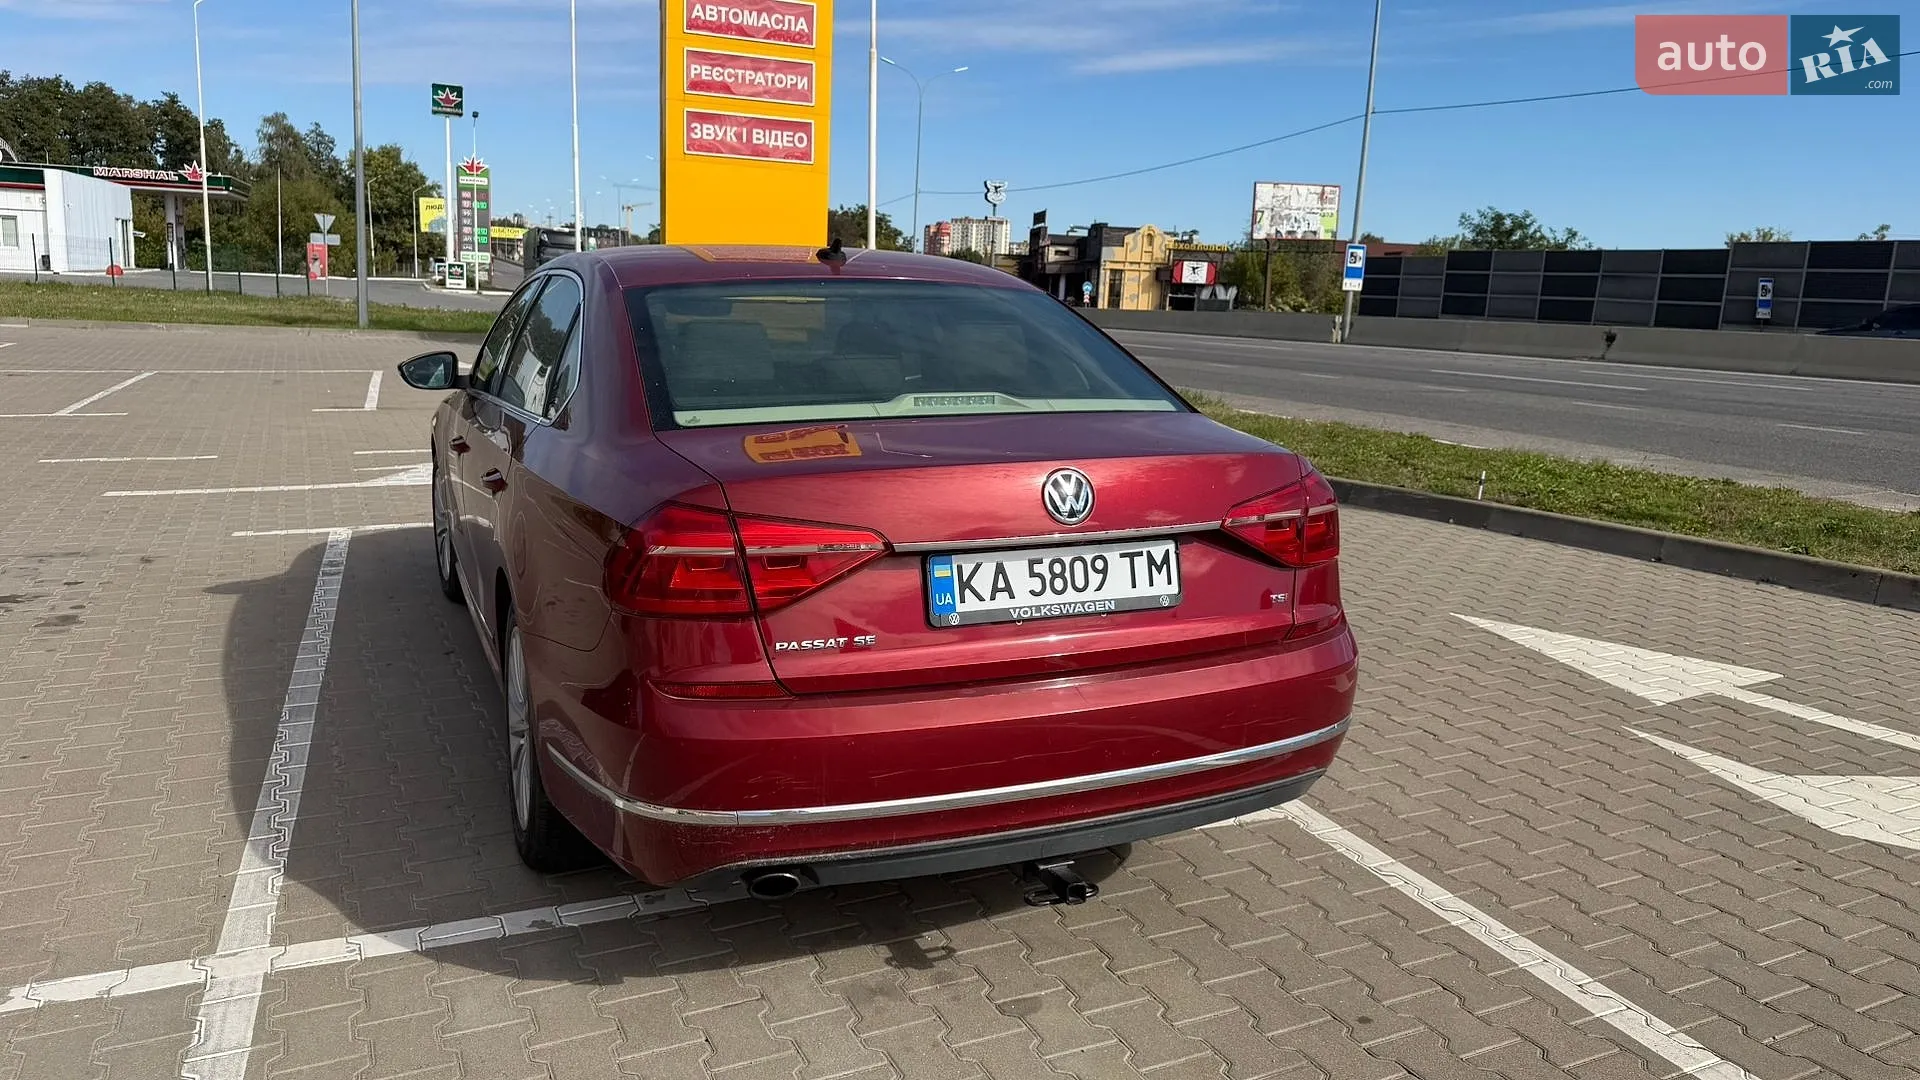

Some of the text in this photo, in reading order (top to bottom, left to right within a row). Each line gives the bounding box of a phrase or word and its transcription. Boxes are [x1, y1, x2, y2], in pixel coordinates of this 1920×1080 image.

[691, 3, 809, 33] АВТОМАСЛА
[690, 63, 808, 91] РЕЄСТРАТОРИ
[690, 122, 808, 149] ЗВУК І ВІДЕО
[93, 166, 179, 181] MARSHAL
[956, 548, 1173, 604] KA 5809 TM
[936, 592, 954, 606] UA
[1009, 600, 1116, 620] VOLKSWAGEN
[775, 634, 877, 652] PASSAT SE
